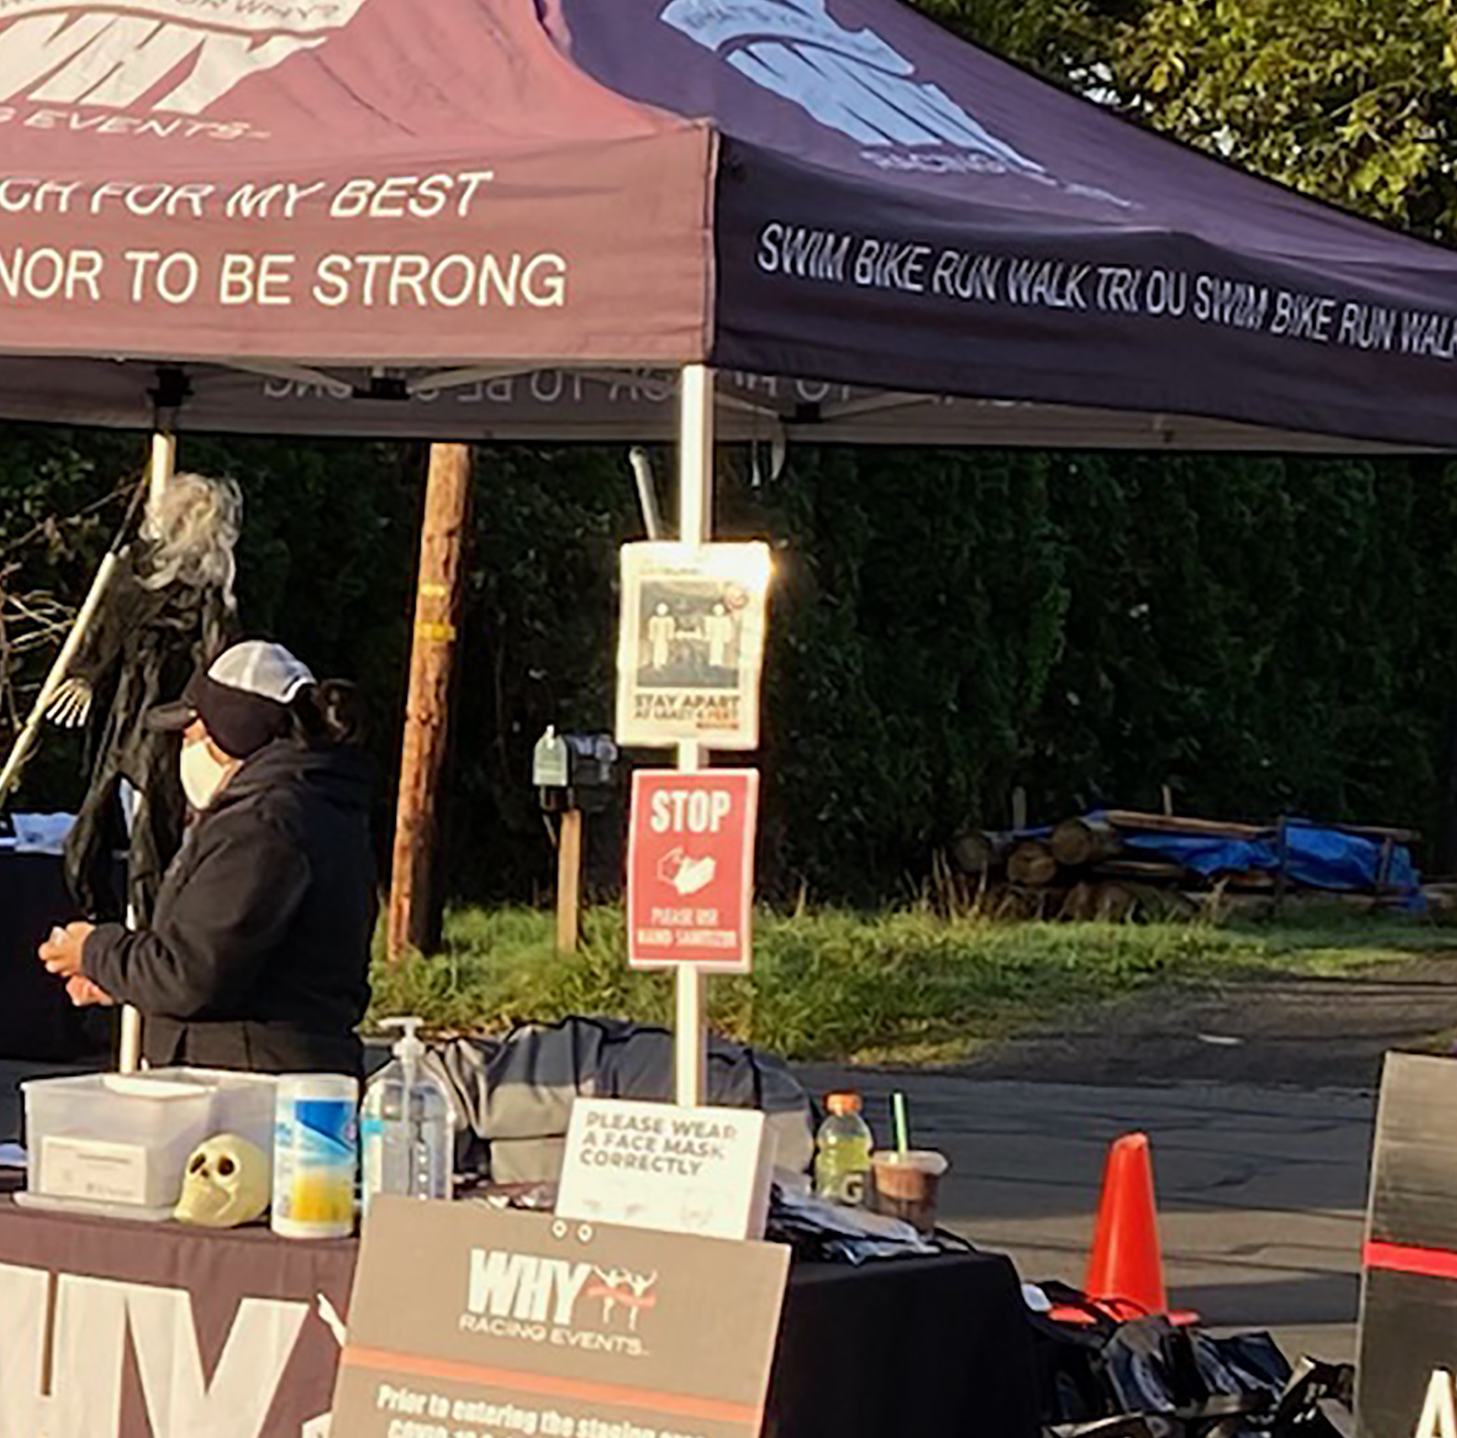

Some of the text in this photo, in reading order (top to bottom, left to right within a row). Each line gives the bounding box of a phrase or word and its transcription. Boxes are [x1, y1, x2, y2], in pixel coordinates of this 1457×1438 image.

[25, 111, 253, 141] EVENTS
[90, 181, 211, 218] FOR
[226, 182, 326, 219] MY
[330, 171, 494, 218] BEST
[123, 249, 198, 304] TO
[218, 253, 295, 306] BE
[313, 252, 568, 308] STRONG
[756, 222, 849, 287] SWIM
[853, 237, 933, 293] BIKE
[933, 249, 1001, 305] RUN
[1006, 259, 1088, 311] WALK
[1096, 265, 1142, 314] TRI
[1145, 269, 1187, 319] DU
[1193, 278, 1270, 331] SWIM
[1271, 289, 1333, 344] BIKE
[1336, 301, 1396, 352] RUN
[634, 694, 741, 709] STAY APART
[650, 788, 731, 834] STOP
[582, 1130, 726, 1160] A FACE MASK
[585, 1111, 738, 1140] PLEASE WEAR
[579, 1148, 703, 1176] CORRECTLY
[841, 1173, 865, 1205] G
[468, 1247, 591, 1326] WHY
[459, 1314, 643, 1357] RACING EVENTS
[377, 1383, 428, 1415] Prior
[428, 1393, 450, 1419] to
[451, 1399, 539, 1434] entering
[540, 1410, 576, 1437] the
